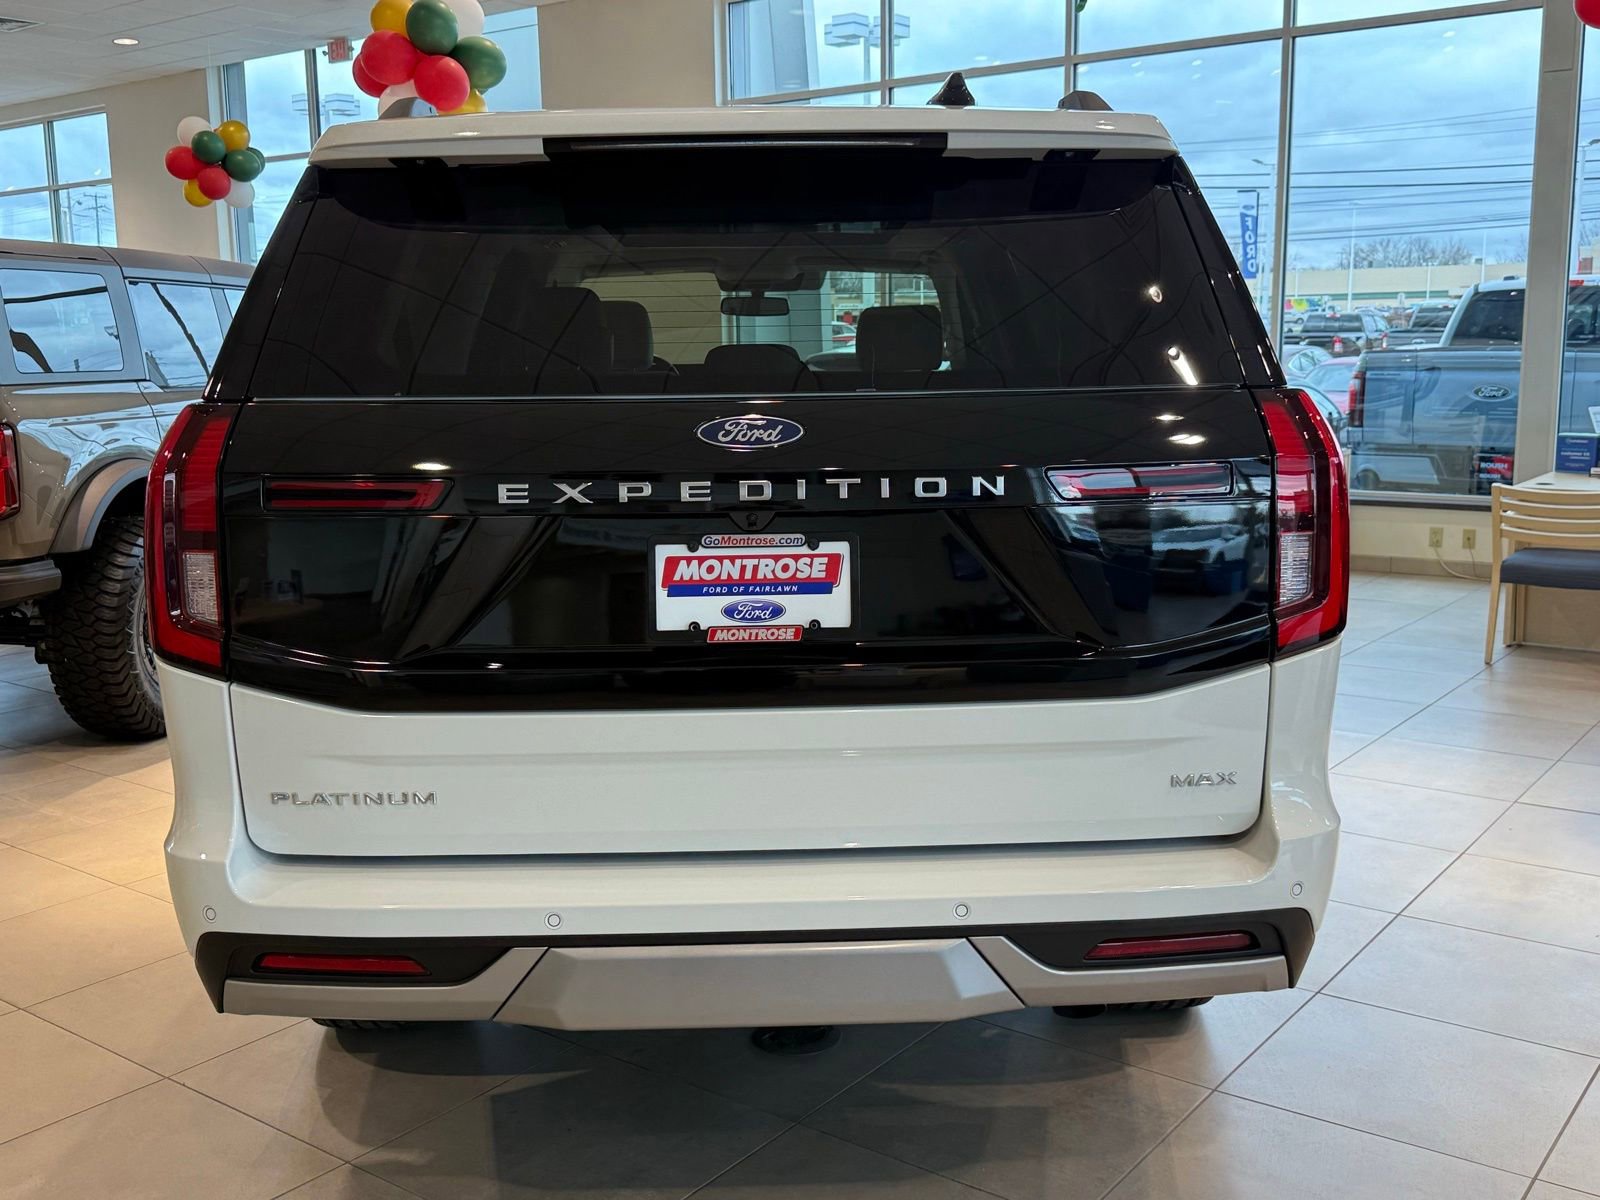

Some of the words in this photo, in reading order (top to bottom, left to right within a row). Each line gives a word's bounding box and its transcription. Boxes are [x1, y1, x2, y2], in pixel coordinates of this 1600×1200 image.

[1478, 386, 1505, 397] Ford
[718, 419, 782, 442] Ford
[498, 475, 1005, 504] EXPEDITION
[703, 535, 804, 546] GoMontrose.com
[672, 557, 828, 581] MONTROSE
[749, 585, 798, 593] FAIRLAWN
[734, 603, 774, 619] Ford
[714, 628, 796, 641] MONTROSE
[1170, 771, 1238, 787] MAX
[270, 791, 438, 806] PLATINUM
